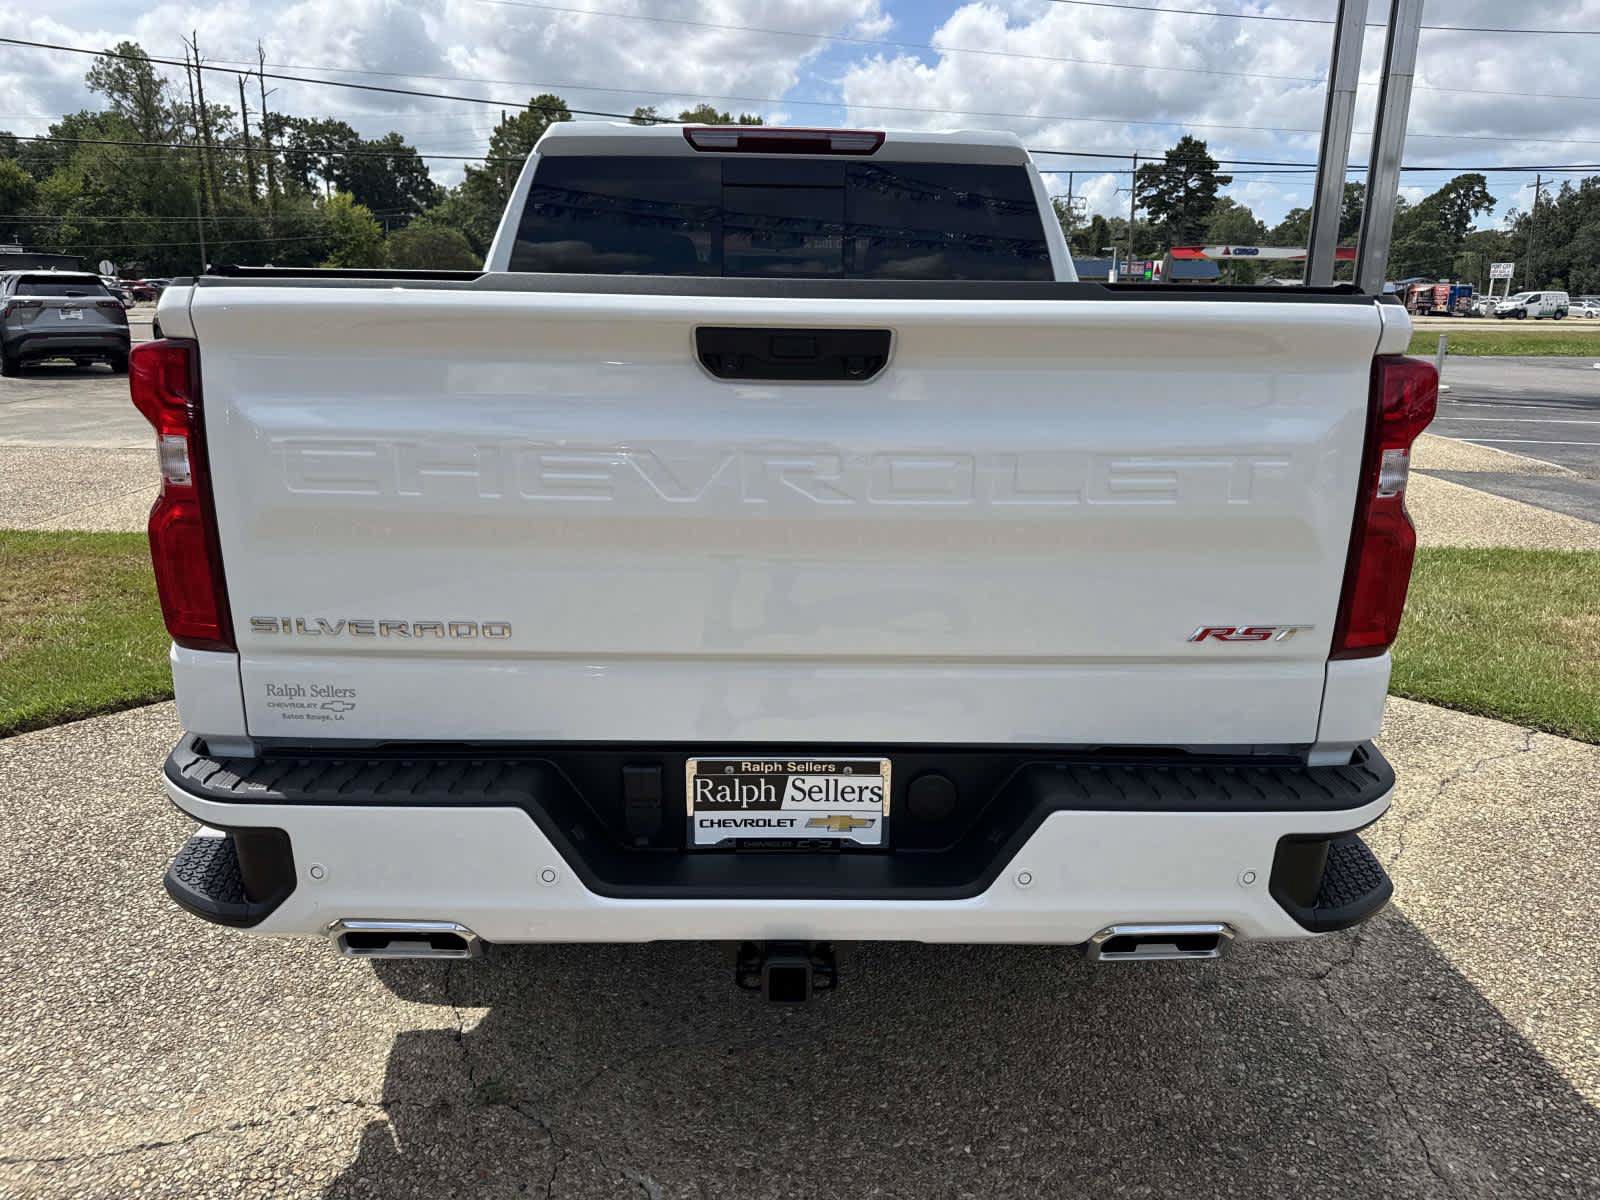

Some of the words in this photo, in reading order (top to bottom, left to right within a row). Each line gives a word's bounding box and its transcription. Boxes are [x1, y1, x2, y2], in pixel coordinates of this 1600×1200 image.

[276, 437, 1293, 506] CHEVROLET
[250, 616, 512, 640] SILVERADO
[1187, 625, 1315, 642] RST
[266, 684, 306, 699] Ralph
[310, 685, 356, 698] Sellers
[741, 762, 783, 774] Ralph
[787, 762, 836, 773] Sellers
[695, 778, 777, 808] Ralph
[791, 777, 883, 803] Sellers
[699, 818, 797, 828] CHEVROLET
